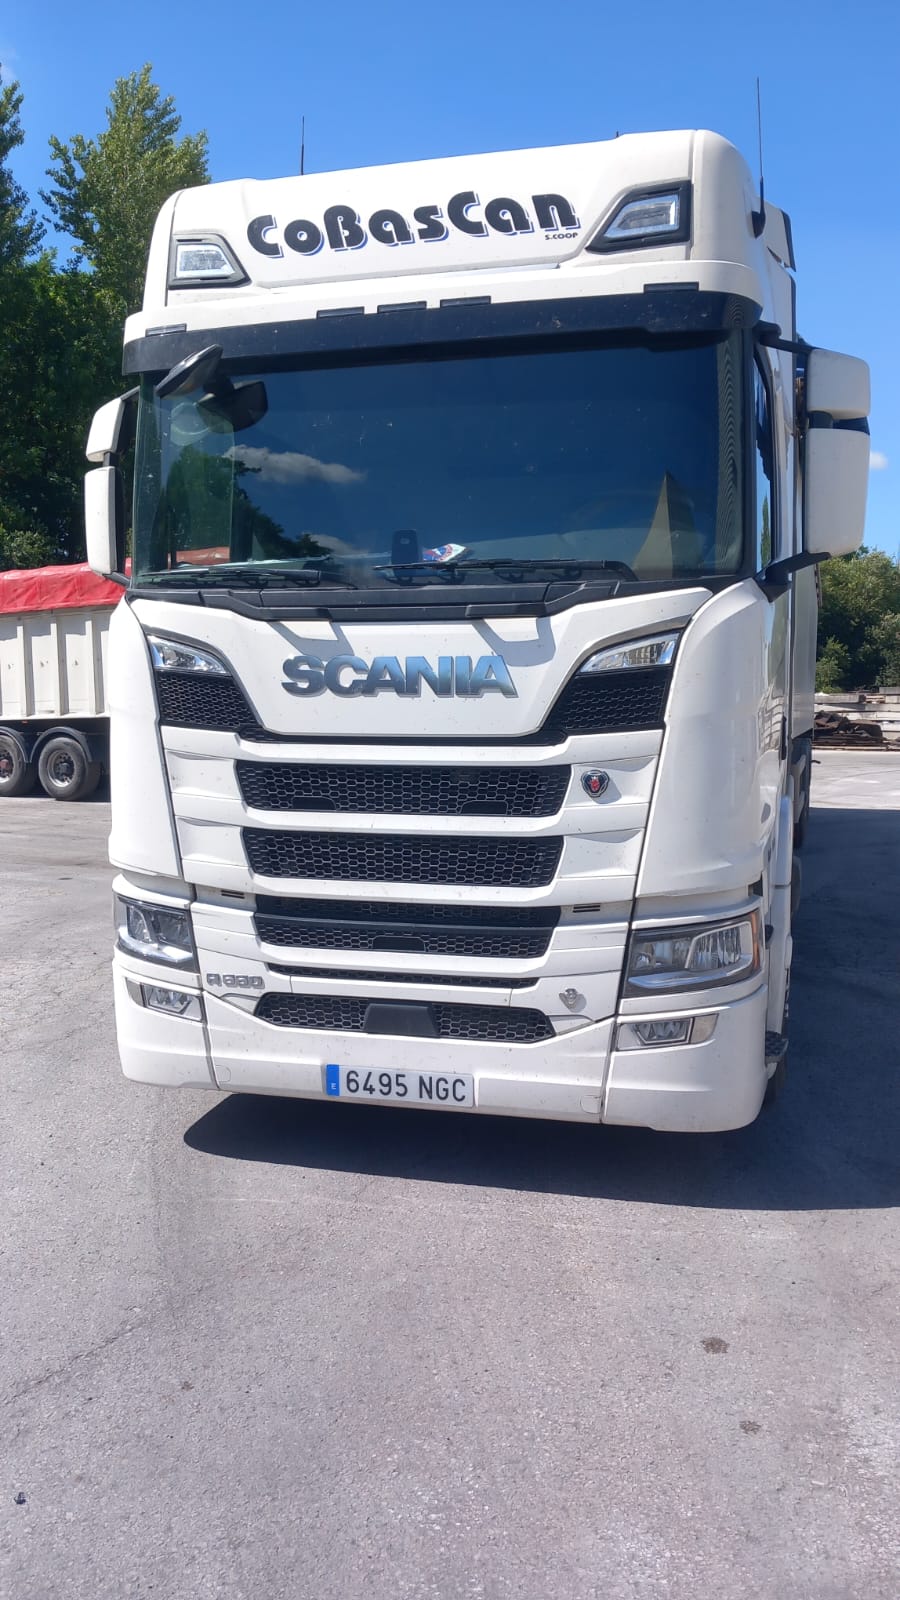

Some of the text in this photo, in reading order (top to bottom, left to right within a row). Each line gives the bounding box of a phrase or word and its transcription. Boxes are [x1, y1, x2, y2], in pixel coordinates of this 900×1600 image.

[247, 191, 580, 258] CoBasCan
[545, 232, 578, 240] S.COOP
[281, 655, 519, 698] SCANIA
[331, 1070, 466, 1102] E 6495 NGC
